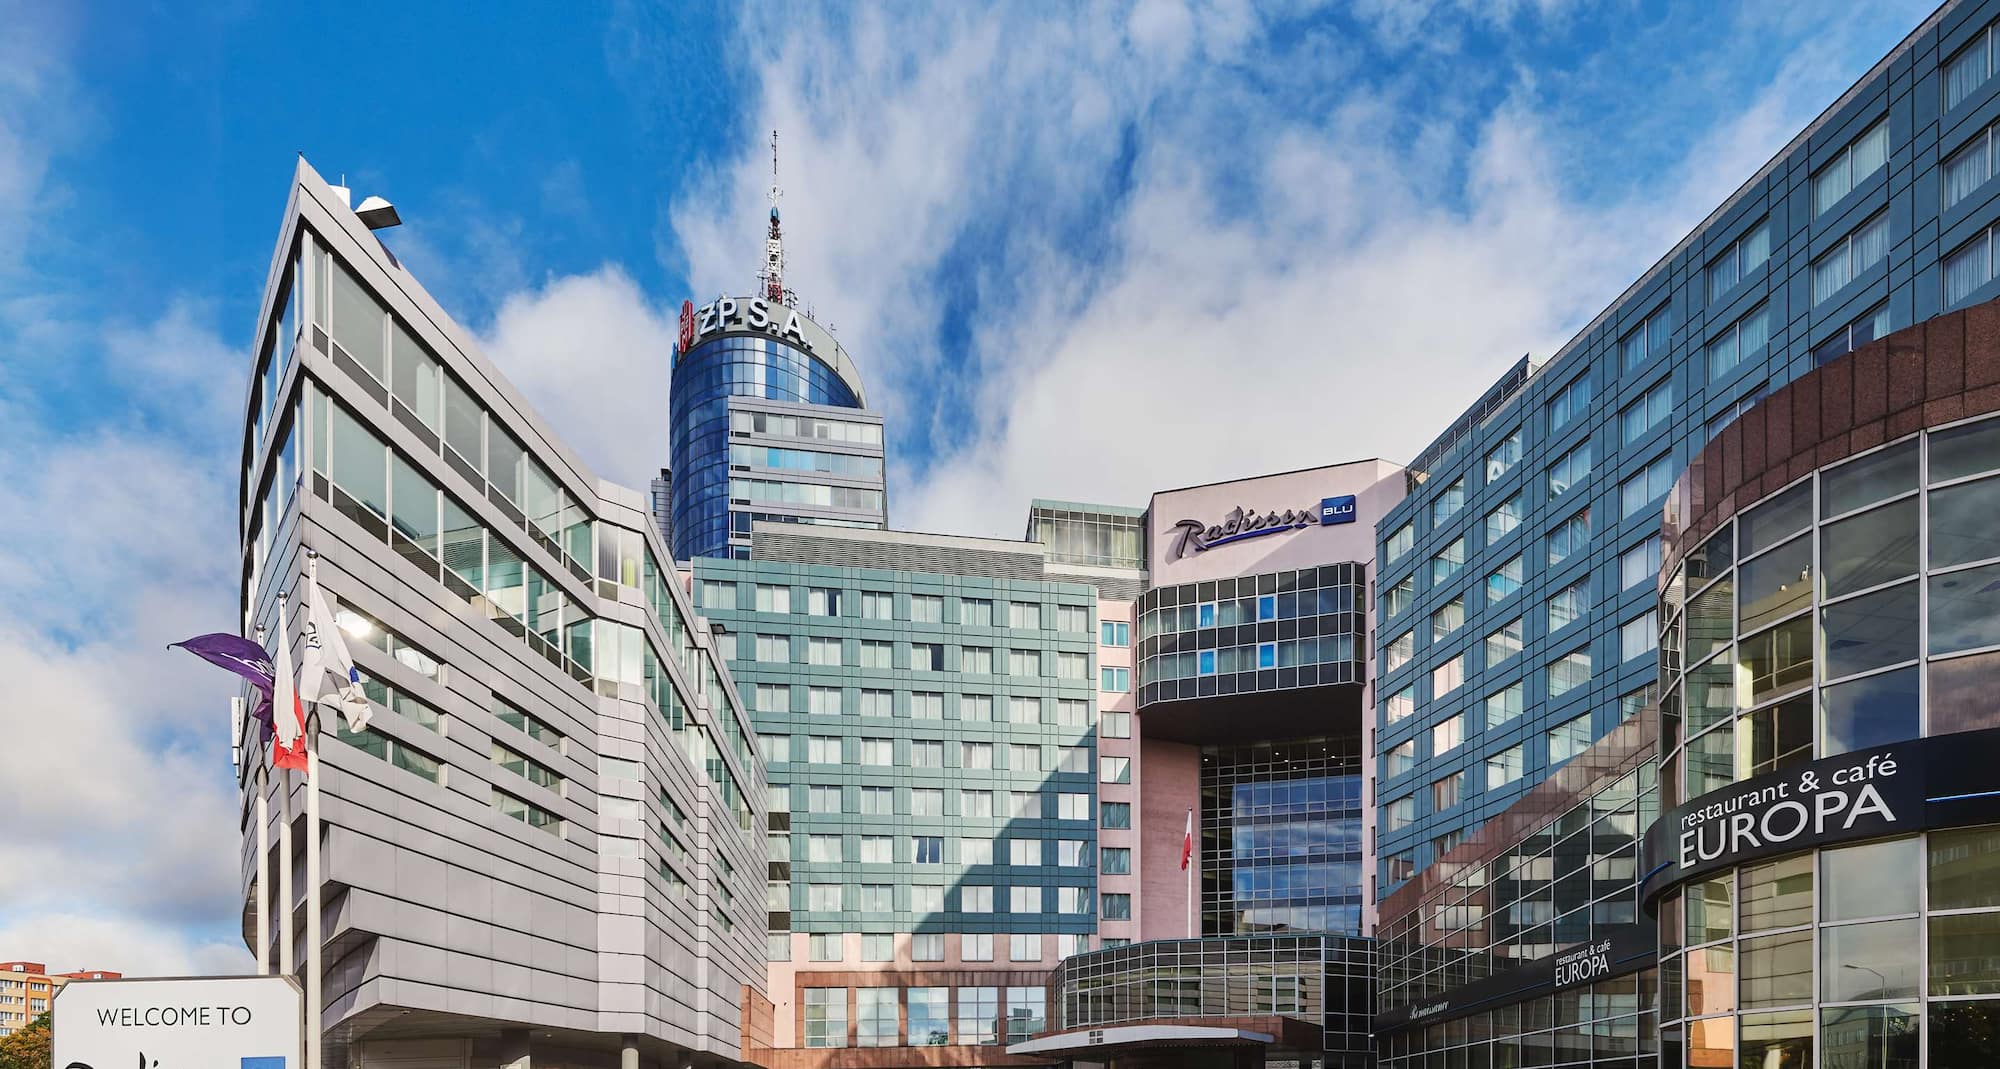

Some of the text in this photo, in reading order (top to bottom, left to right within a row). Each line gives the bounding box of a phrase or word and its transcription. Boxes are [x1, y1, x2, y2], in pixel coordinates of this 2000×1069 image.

[1323, 504, 1353, 516] BLU
[1175, 506, 1318, 559] Radisson
[1681, 752, 1897, 830] restaurant & café
[1680, 783, 1897, 869] EUROPA
[1555, 949, 1588, 966] restaurant
[1589, 944, 1596, 955] &
[1555, 953, 1609, 987] EUROPA
[97, 1006, 251, 1027] WELCOME TO
